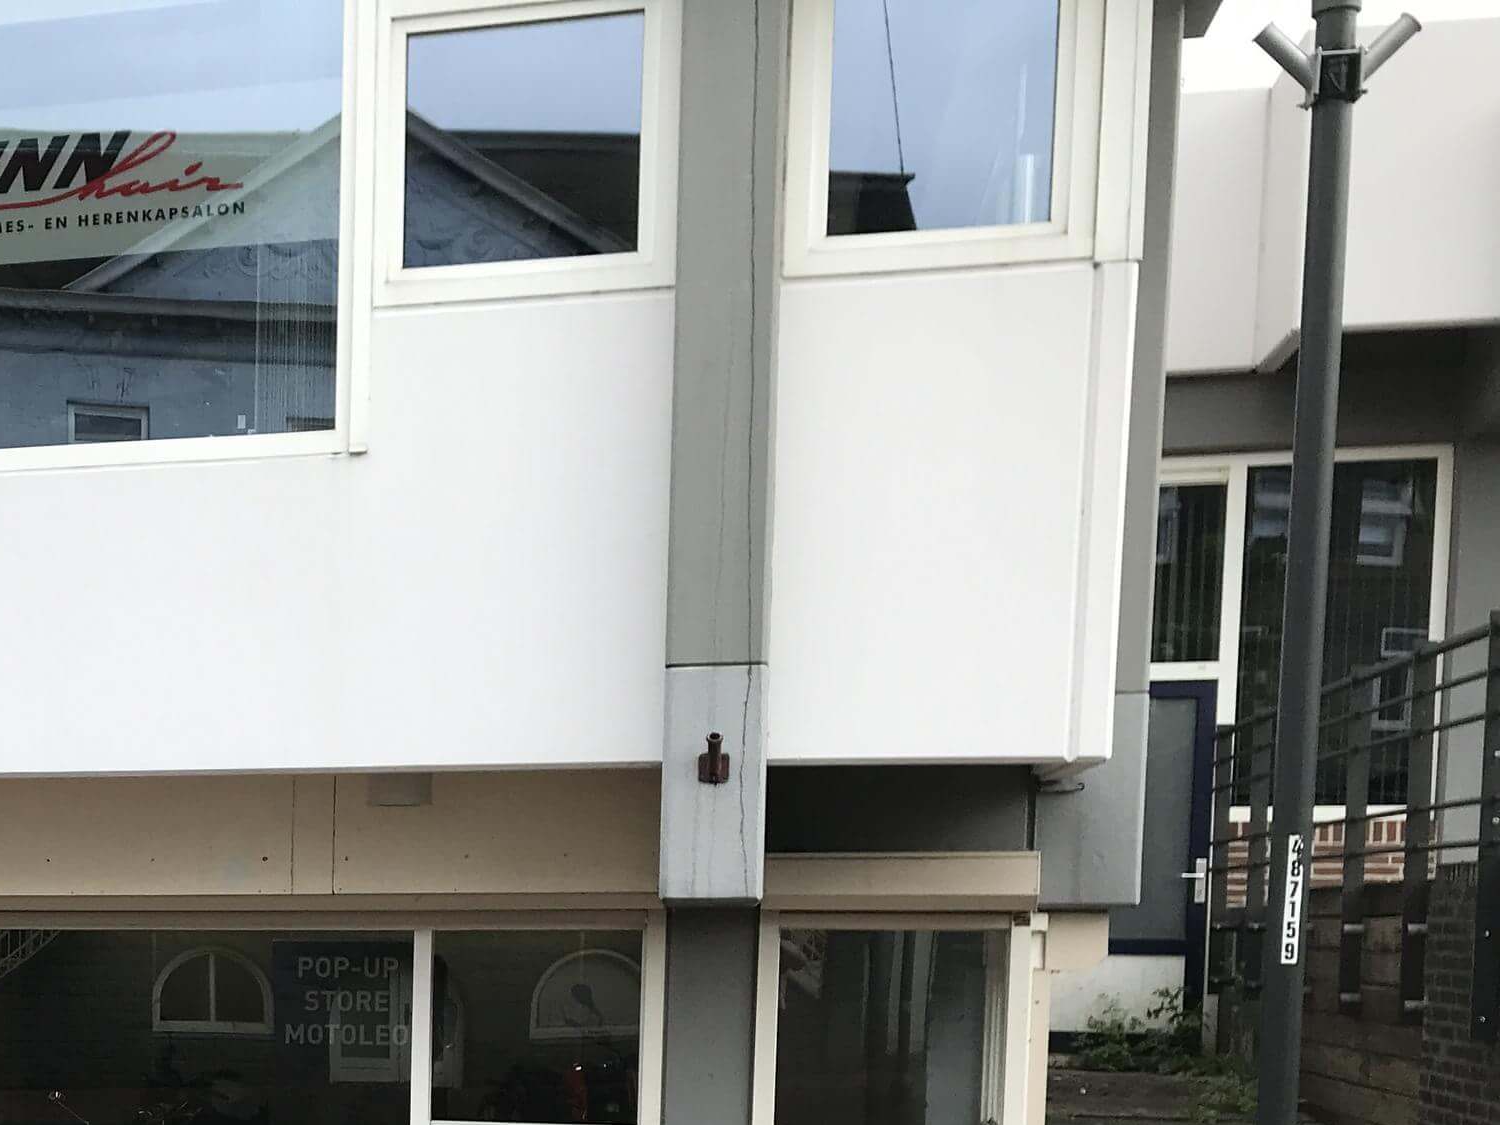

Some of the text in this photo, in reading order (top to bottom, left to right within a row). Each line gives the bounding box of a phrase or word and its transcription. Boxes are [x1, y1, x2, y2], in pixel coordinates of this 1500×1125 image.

[44, 215, 68, 230] EN
[78, 201, 246, 228] HERENKAPSALON
[1284, 839, 1303, 960] 487159
[297, 955, 400, 978] POP-UP
[304, 990, 389, 1012] STORE
[285, 1023, 409, 1046] MOTOLEO
